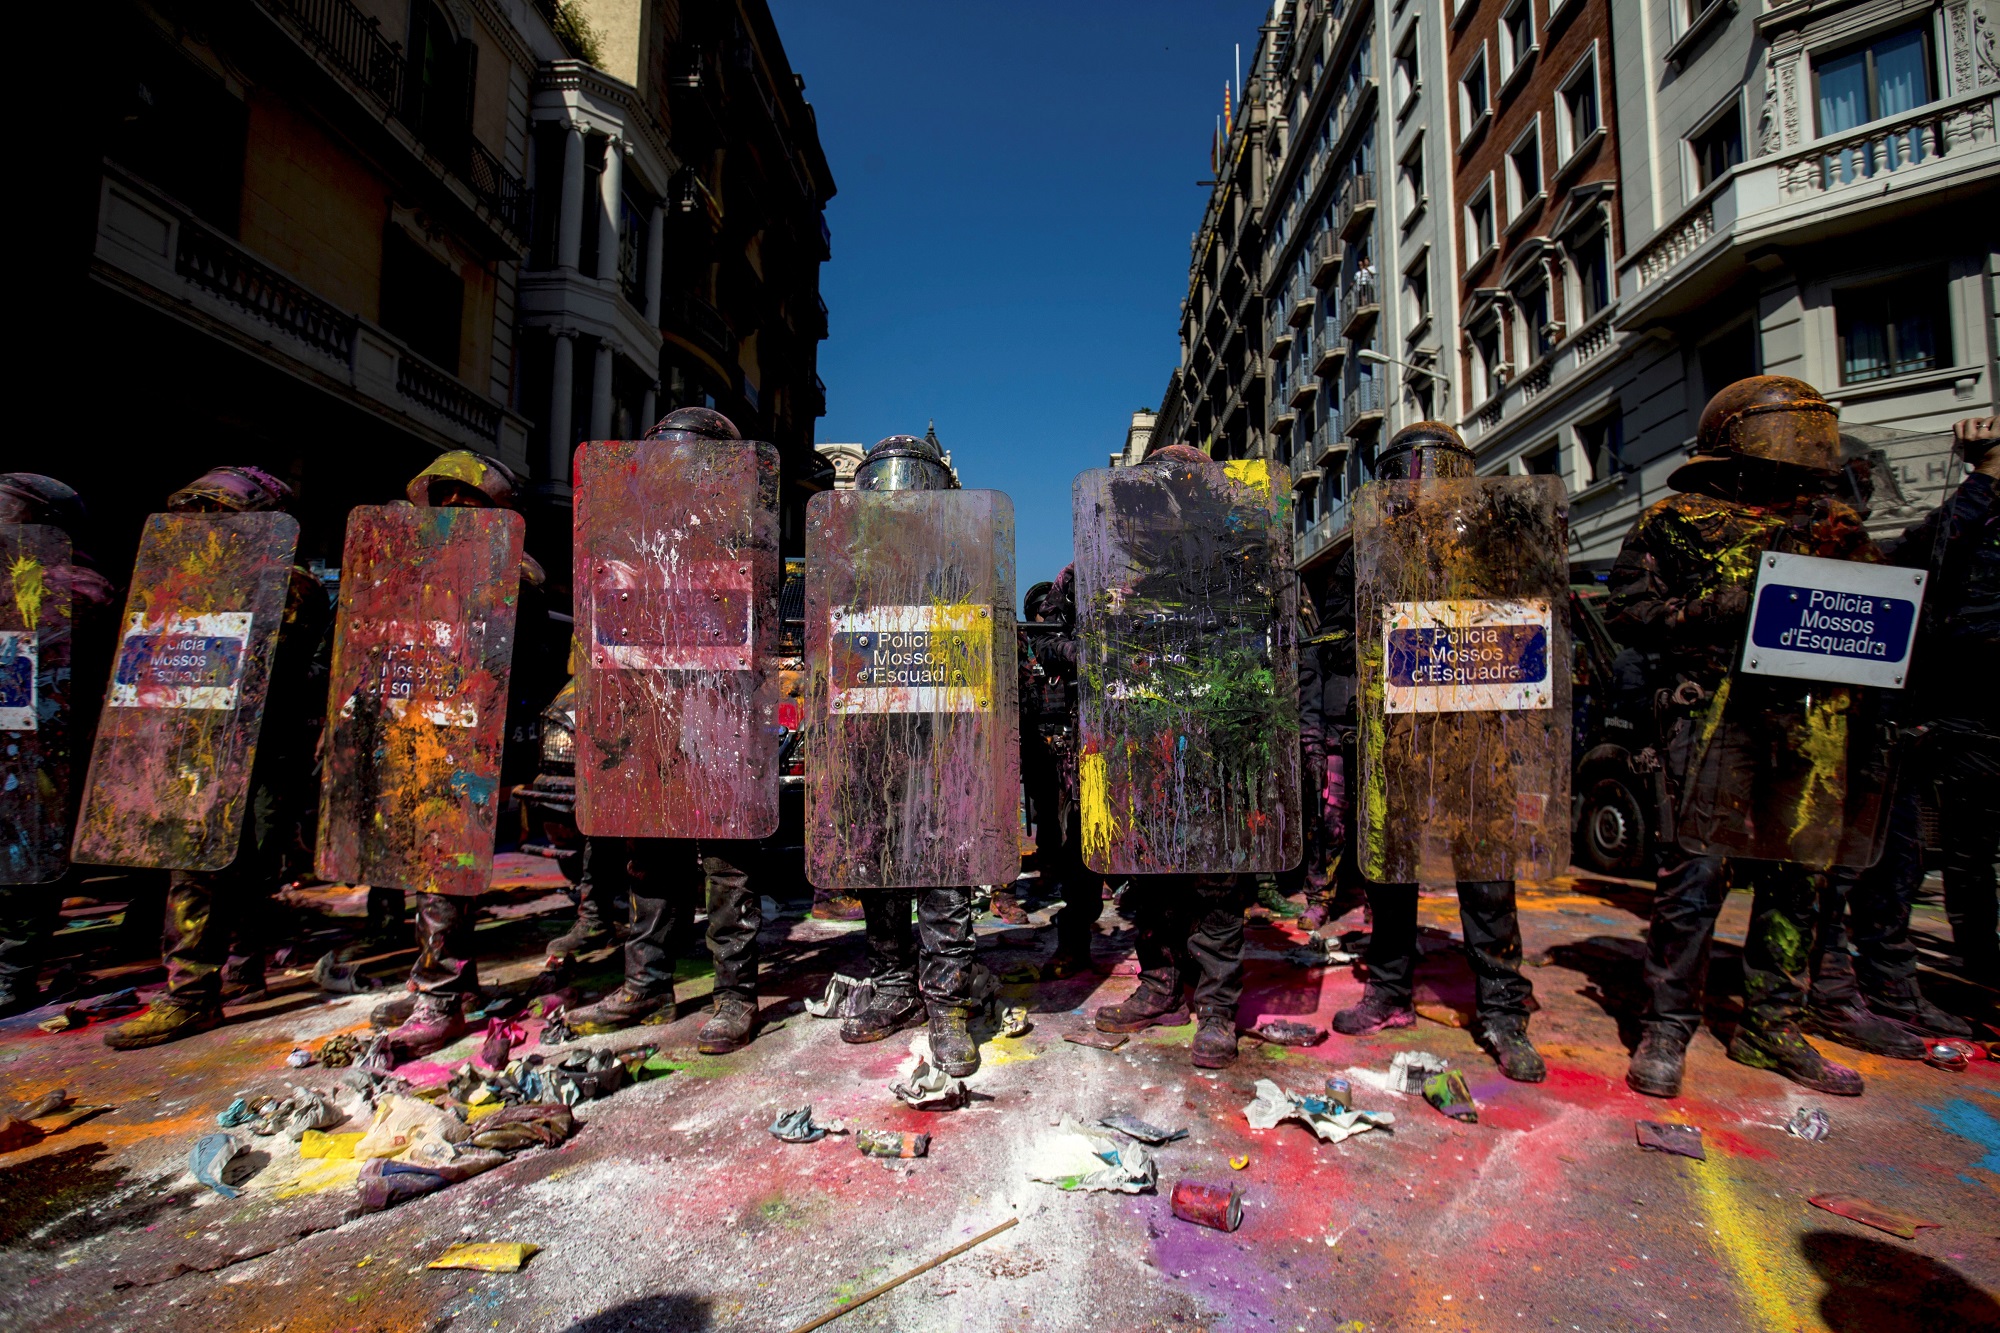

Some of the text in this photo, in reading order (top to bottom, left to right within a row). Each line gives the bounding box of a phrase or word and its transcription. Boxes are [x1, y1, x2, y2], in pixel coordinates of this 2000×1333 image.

[1809, 589, 1874, 615] Policia
[1800, 608, 1875, 635] Mossos
[1434, 626, 1498, 646] Policia
[1779, 627, 1887, 656] d'Esquadra
[873, 649, 946, 666] Mossos
[1428, 646, 1504, 664] Mossos
[1411, 661, 1520, 685] d'Esquadra
